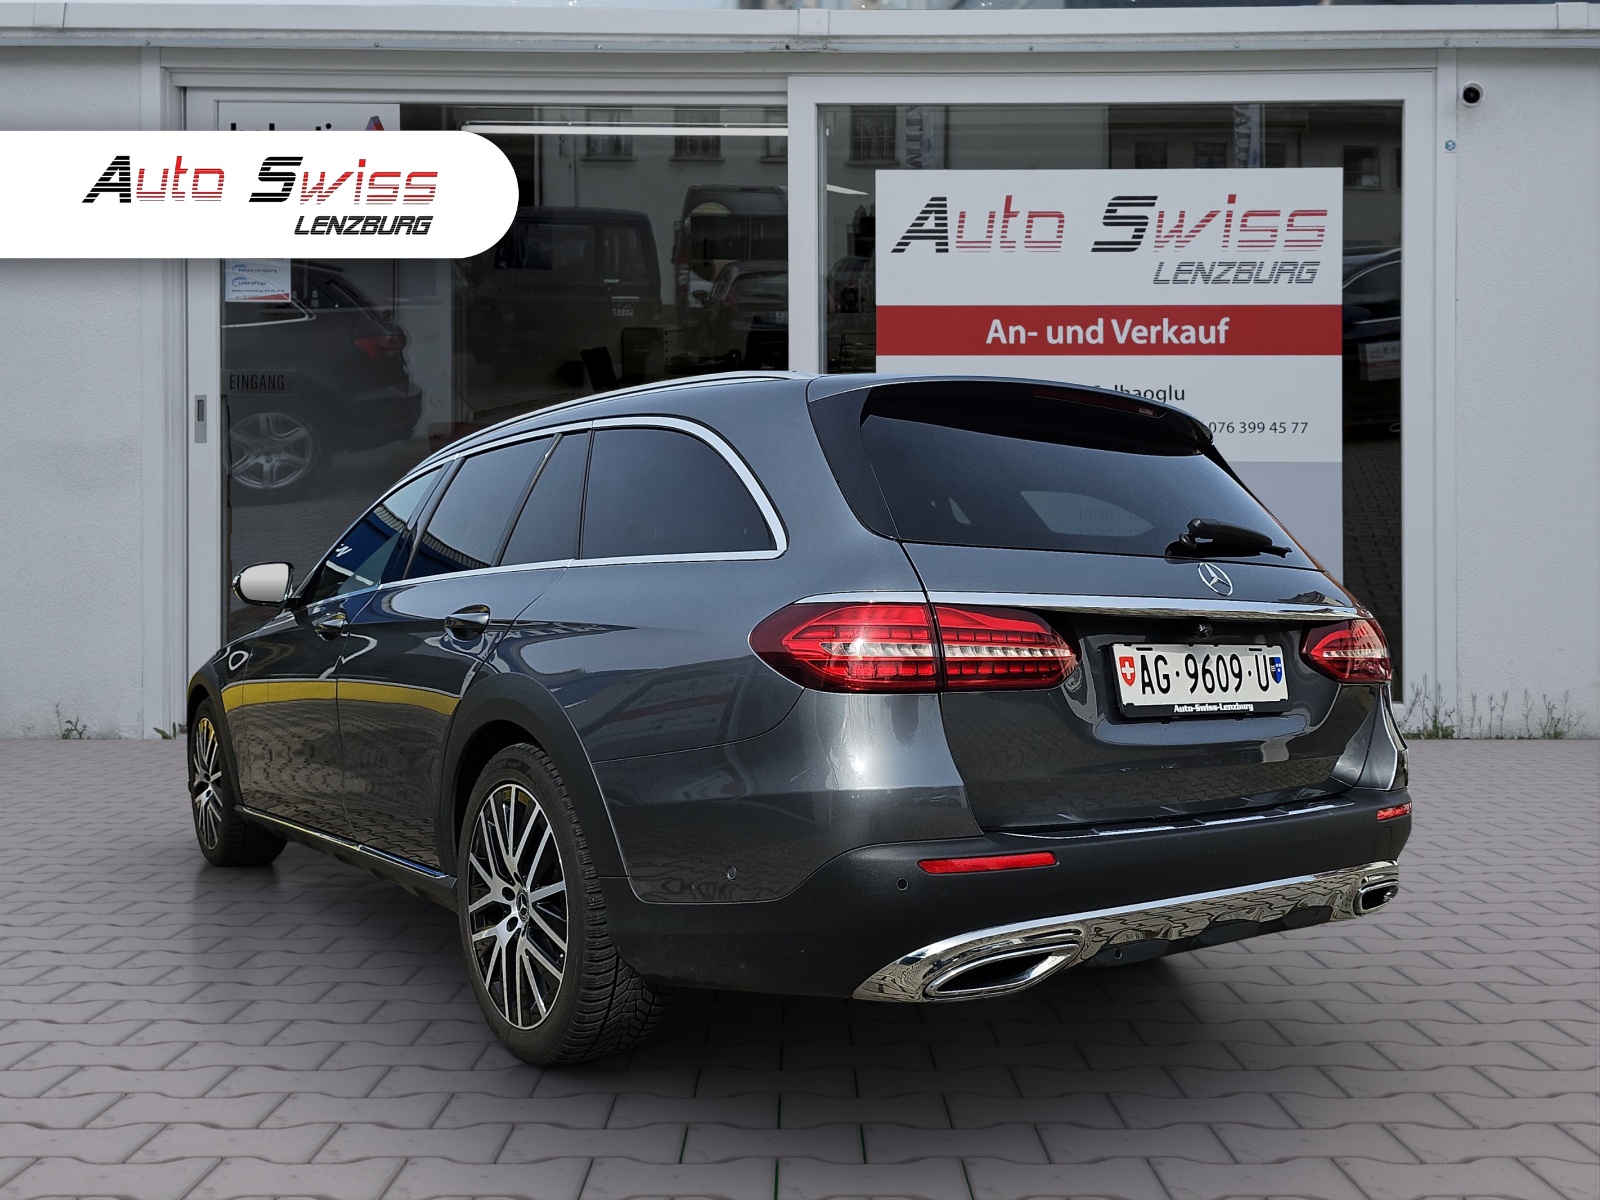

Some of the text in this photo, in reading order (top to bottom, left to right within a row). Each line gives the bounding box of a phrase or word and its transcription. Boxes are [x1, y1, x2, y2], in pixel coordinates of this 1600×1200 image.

[891, 193, 1328, 254] Auto Swiss
[1153, 261, 1321, 285] LENZBURG
[985, 317, 1231, 345] An- und Verkauf
[228, 374, 286, 392] EINGANG
[1208, 420, 1309, 434] 076 399 45 77
[1173, 702, 1255, 713] Auto-Swiss-Lenzburg
